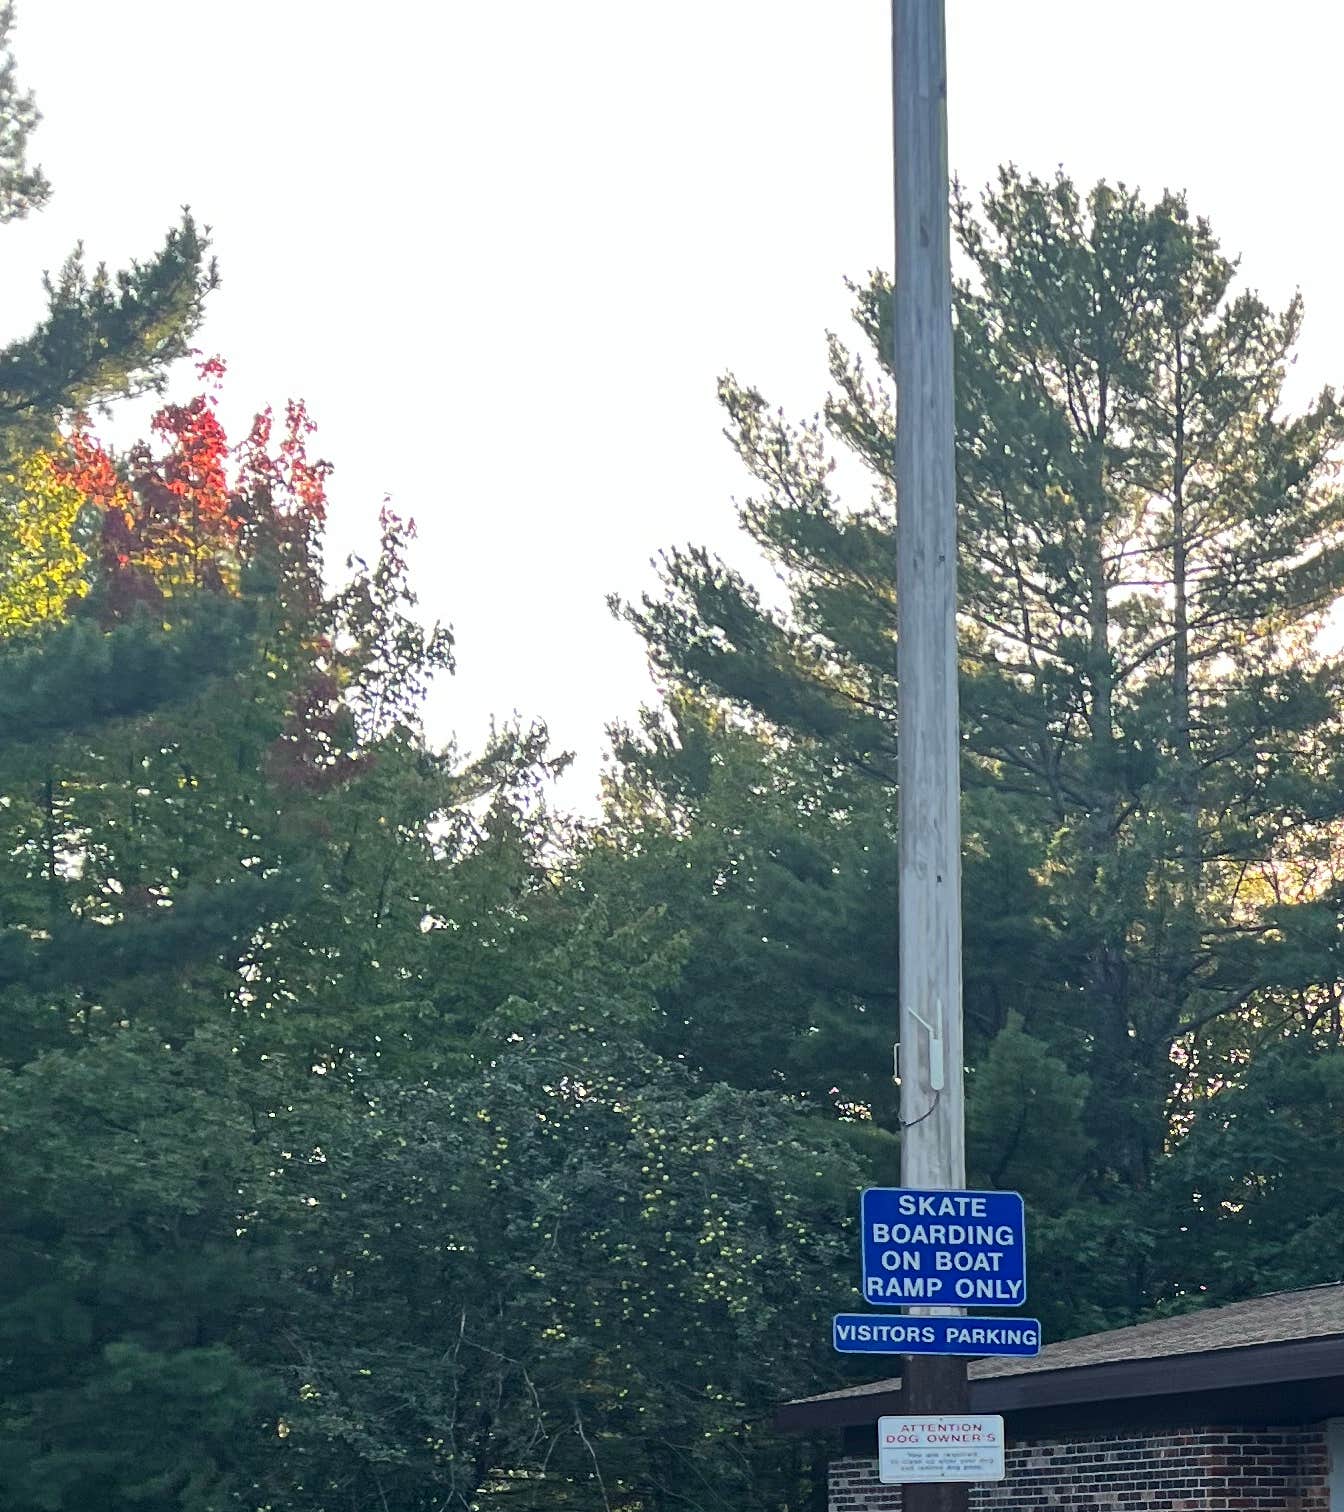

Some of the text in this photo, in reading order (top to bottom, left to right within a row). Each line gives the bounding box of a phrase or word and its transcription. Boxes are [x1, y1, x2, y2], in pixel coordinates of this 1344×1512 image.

[899, 1196, 987, 1217] SKATE
[873, 1224, 1014, 1246] BOARDING
[881, 1250, 1003, 1272] ON BOAT
[867, 1277, 1022, 1299] RAMP ONLY
[837, 1324, 1037, 1346] VISITORS PARKING
[901, 1423, 982, 1432] ATTENTION
[886, 1435, 919, 1443] DOG
